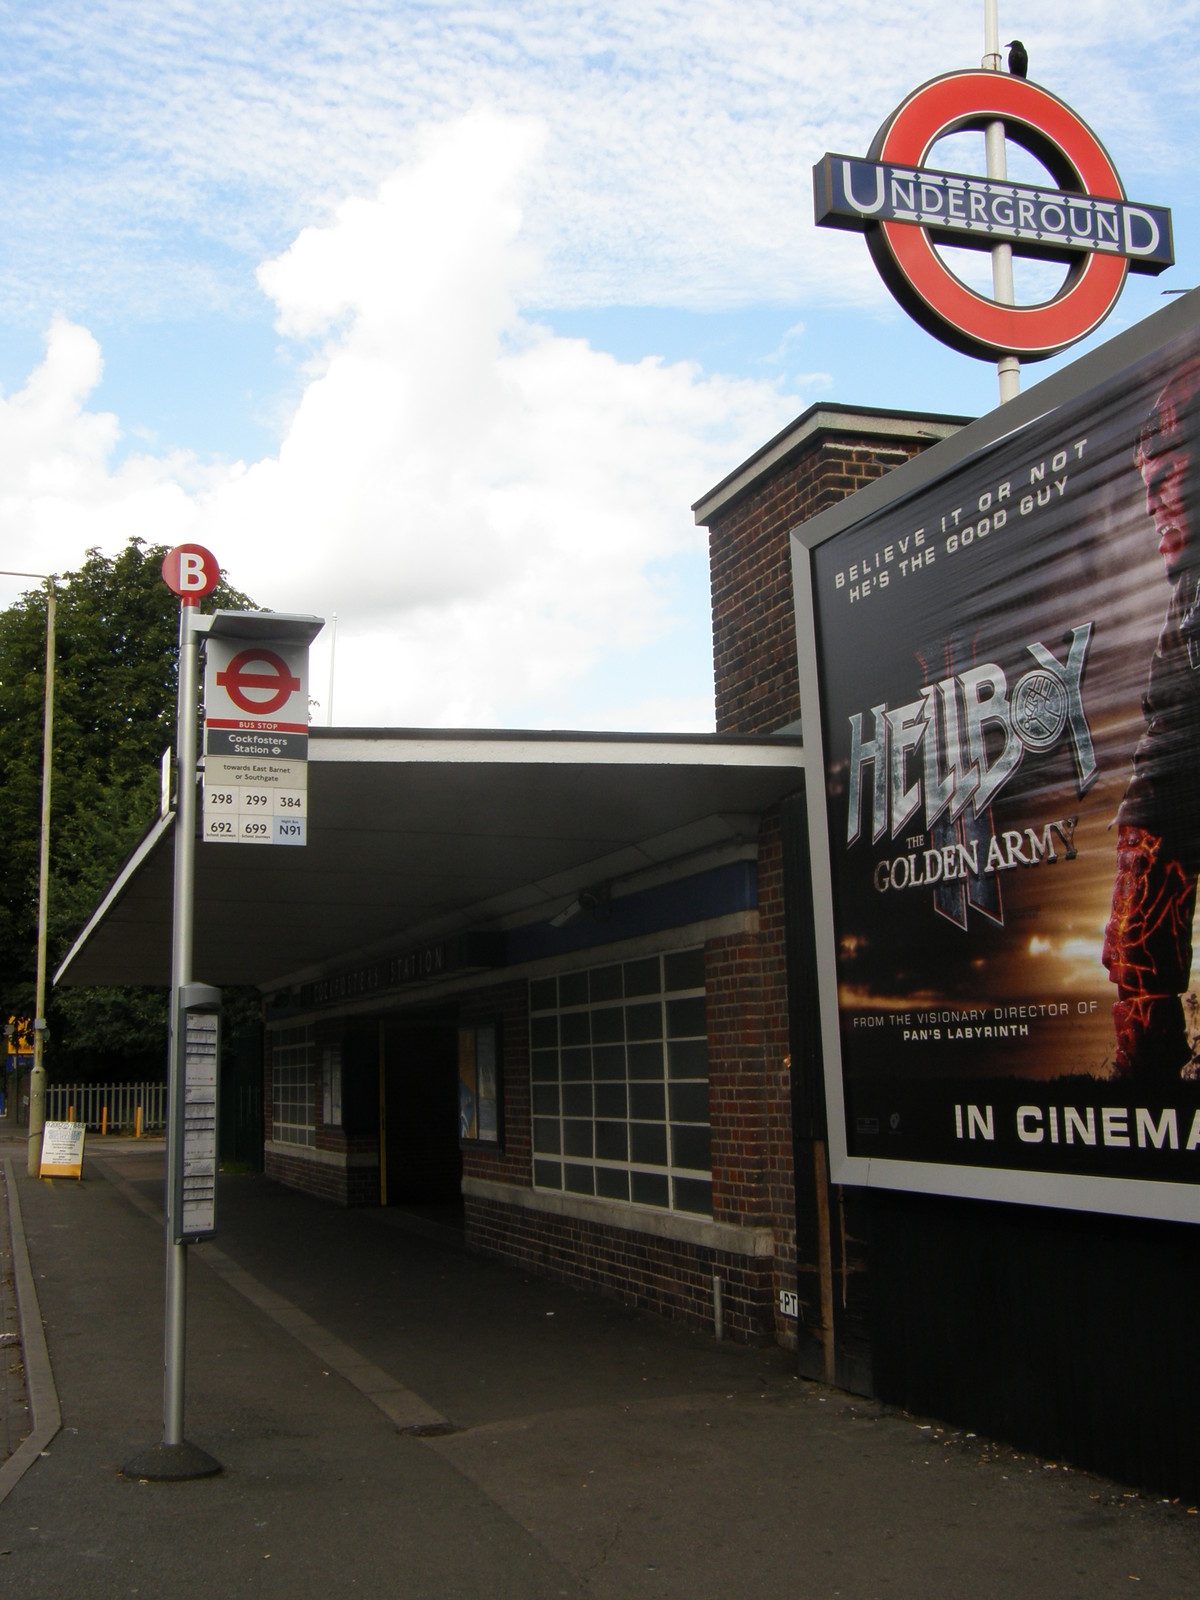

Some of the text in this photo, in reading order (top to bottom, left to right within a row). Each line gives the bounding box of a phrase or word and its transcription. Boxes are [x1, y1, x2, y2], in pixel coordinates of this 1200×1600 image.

[841, 160, 1160, 256] UNDERGROUND
[835, 438, 1088, 590] BELIEVE IT OR NOT
[849, 474, 1069, 604] HE'S THE GOOD GUY
[179, 552, 208, 592] B
[238, 721, 278, 730] BUS STOP
[228, 734, 288, 746] Cockfosters
[847, 621, 1098, 850] HELLBOY
[234, 744, 269, 754] Station
[253, 765, 267, 773] East
[269, 766, 291, 774] Barnet
[245, 773, 279, 783] Southgate
[211, 793, 233, 805] 298
[246, 795, 268, 806] 299
[280, 796, 302, 808] 384
[211, 822, 232, 833] 692
[245, 823, 267, 835] 699
[279, 825, 301, 836] N91
[906, 834, 925, 850] THE
[873, 816, 1079, 893] GOLDEN ARMY
[853, 1000, 1099, 1028] FROM THE VISIONARY DIRECTOR OF
[902, 1023, 1029, 1042] PAN'S LABYRINTH
[953, 1104, 996, 1141] IN
